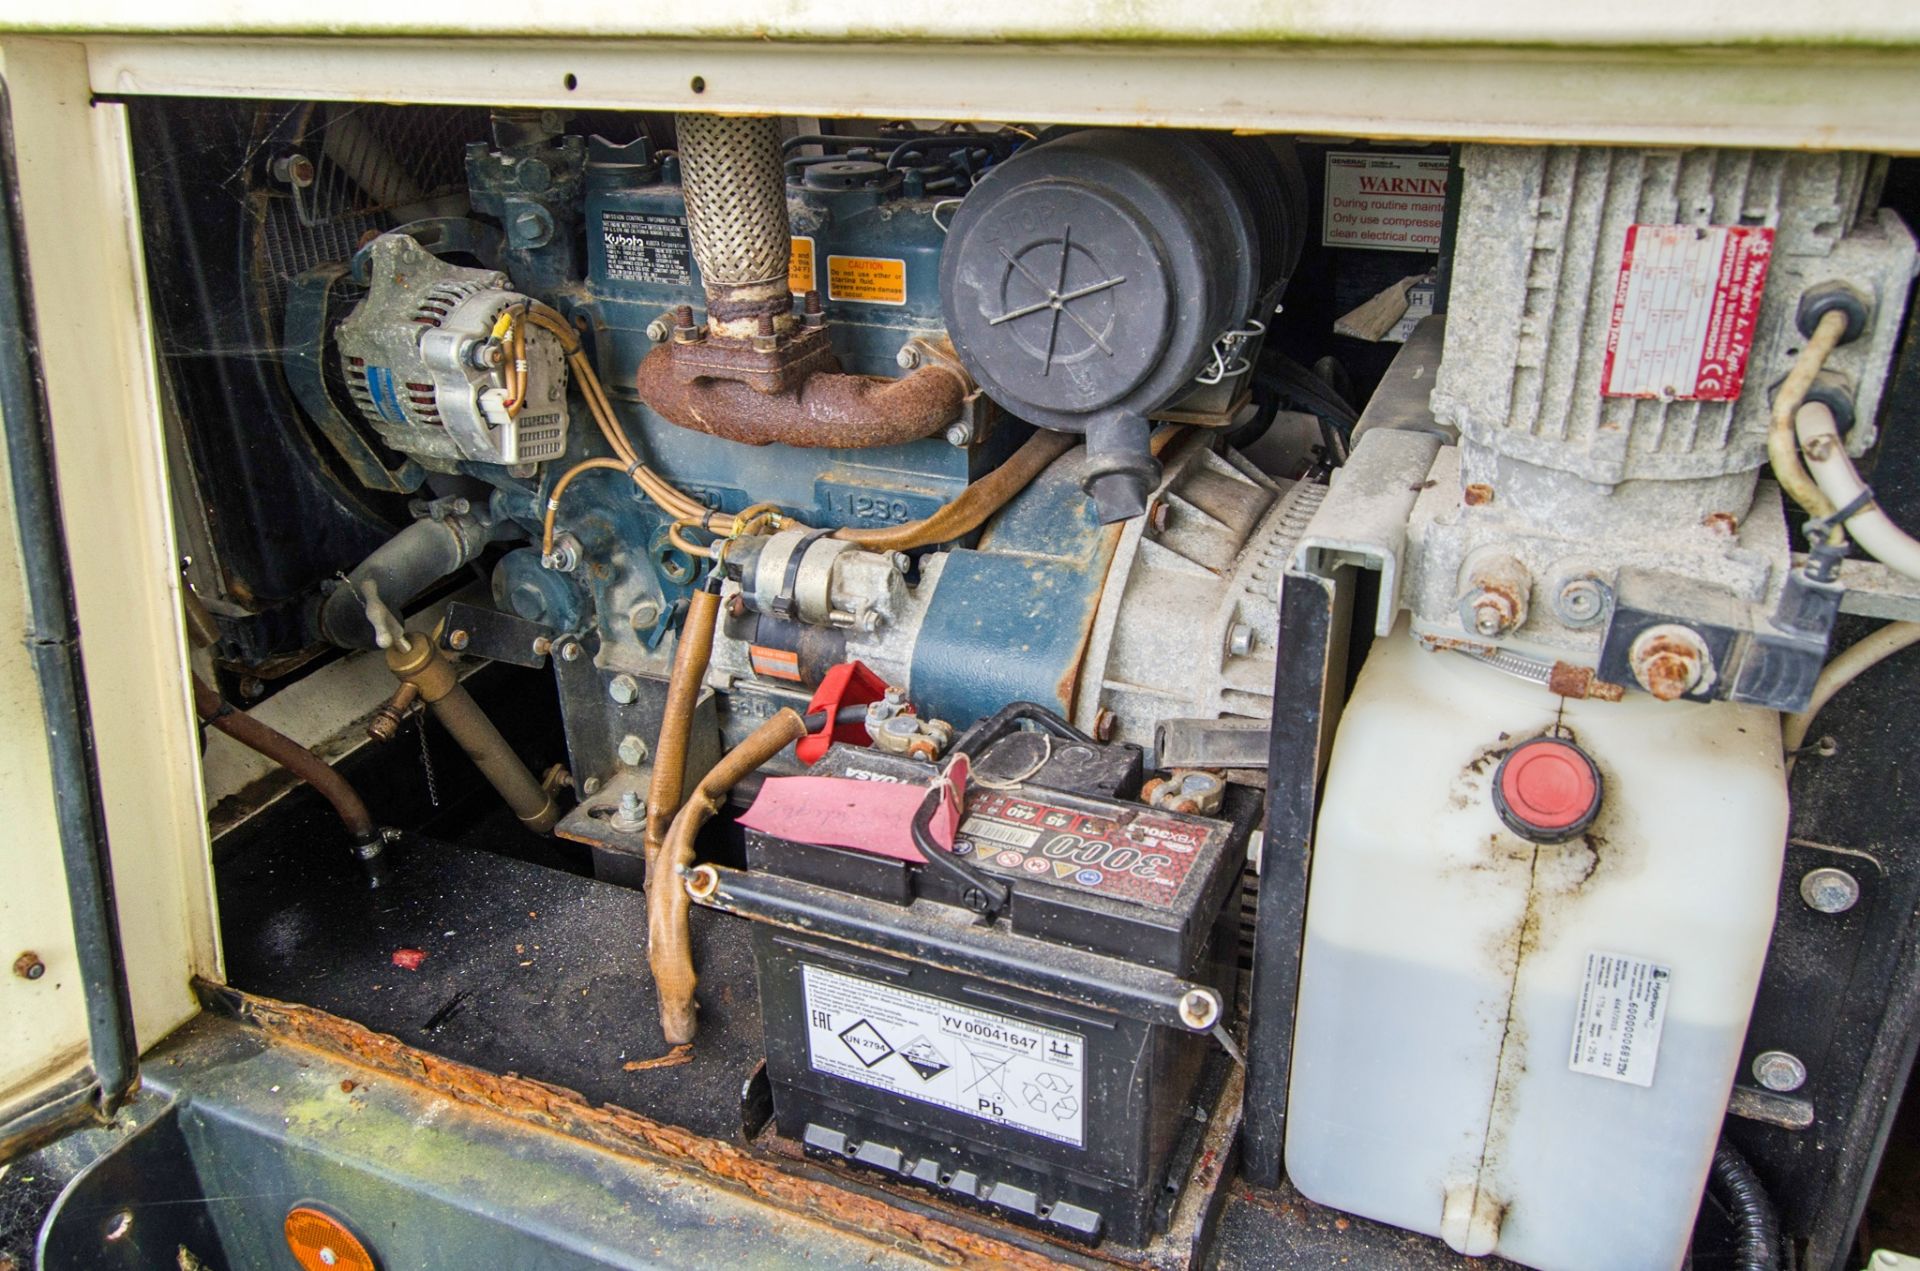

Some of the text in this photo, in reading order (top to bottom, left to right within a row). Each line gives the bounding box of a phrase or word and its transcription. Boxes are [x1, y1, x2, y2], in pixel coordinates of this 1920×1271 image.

[1333, 197, 1368, 211] During
[1371, 200, 1408, 211] routine
[1333, 213, 1359, 226] Only
[1360, 216, 1380, 225] use
[604, 233, 644, 247] Kubota
[1330, 228, 1358, 239] clean
[1360, 230, 1408, 241] electrical
[848, 260, 884, 270] CAUTION
[831, 277, 856, 285] starting
[1705, 236, 1738, 361] MOTORE ASINCRONO
[1608, 270, 1630, 353] MADE IN ITALY
[1006, 806, 1036, 821] 440
[1045, 816, 1067, 828] 45
[1043, 834, 1173, 879] 3000
[812, 1010, 833, 1032] EAC
[942, 1014, 962, 1030] YV
[964, 1022, 1038, 1050] 00041647
[846, 1035, 886, 1052] UN 2794
[978, 1098, 1004, 1117] Pb
